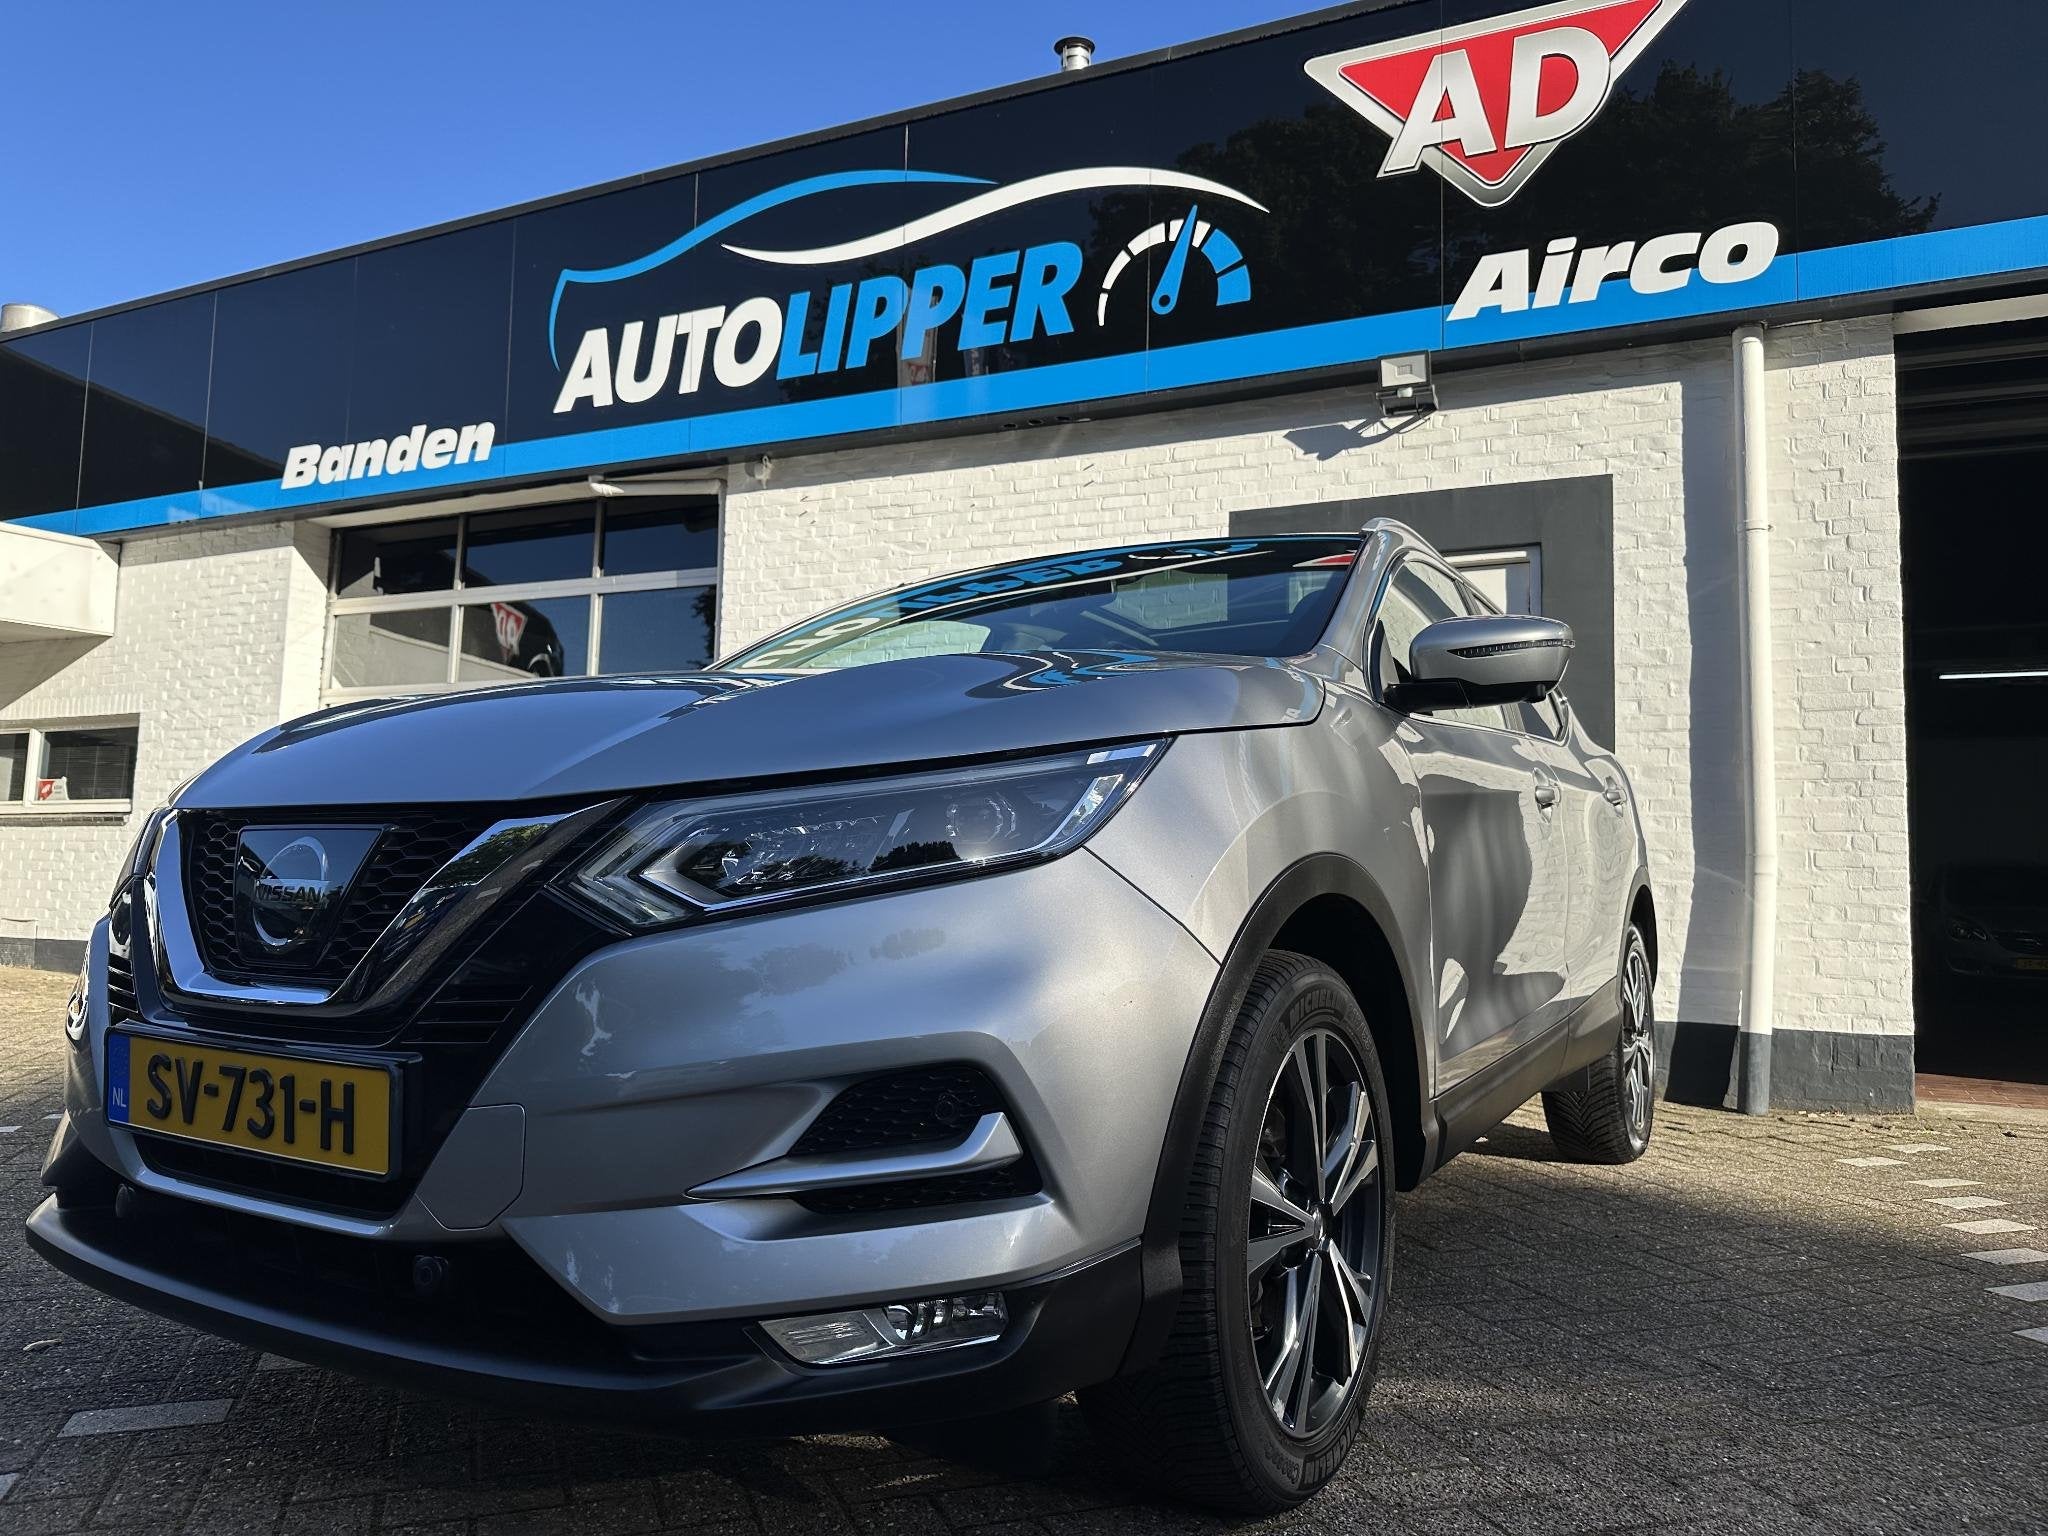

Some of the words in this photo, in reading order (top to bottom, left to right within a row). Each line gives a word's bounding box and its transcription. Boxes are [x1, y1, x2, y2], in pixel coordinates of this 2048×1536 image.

[1379, 26, 1611, 178] AD
[1446, 220, 1780, 321] Airco
[280, 421, 496, 490] Banden
[255, 883, 326, 902] NISSAN
[112, 1085, 127, 1108] NL
[146, 1052, 355, 1155] SV-731-H
